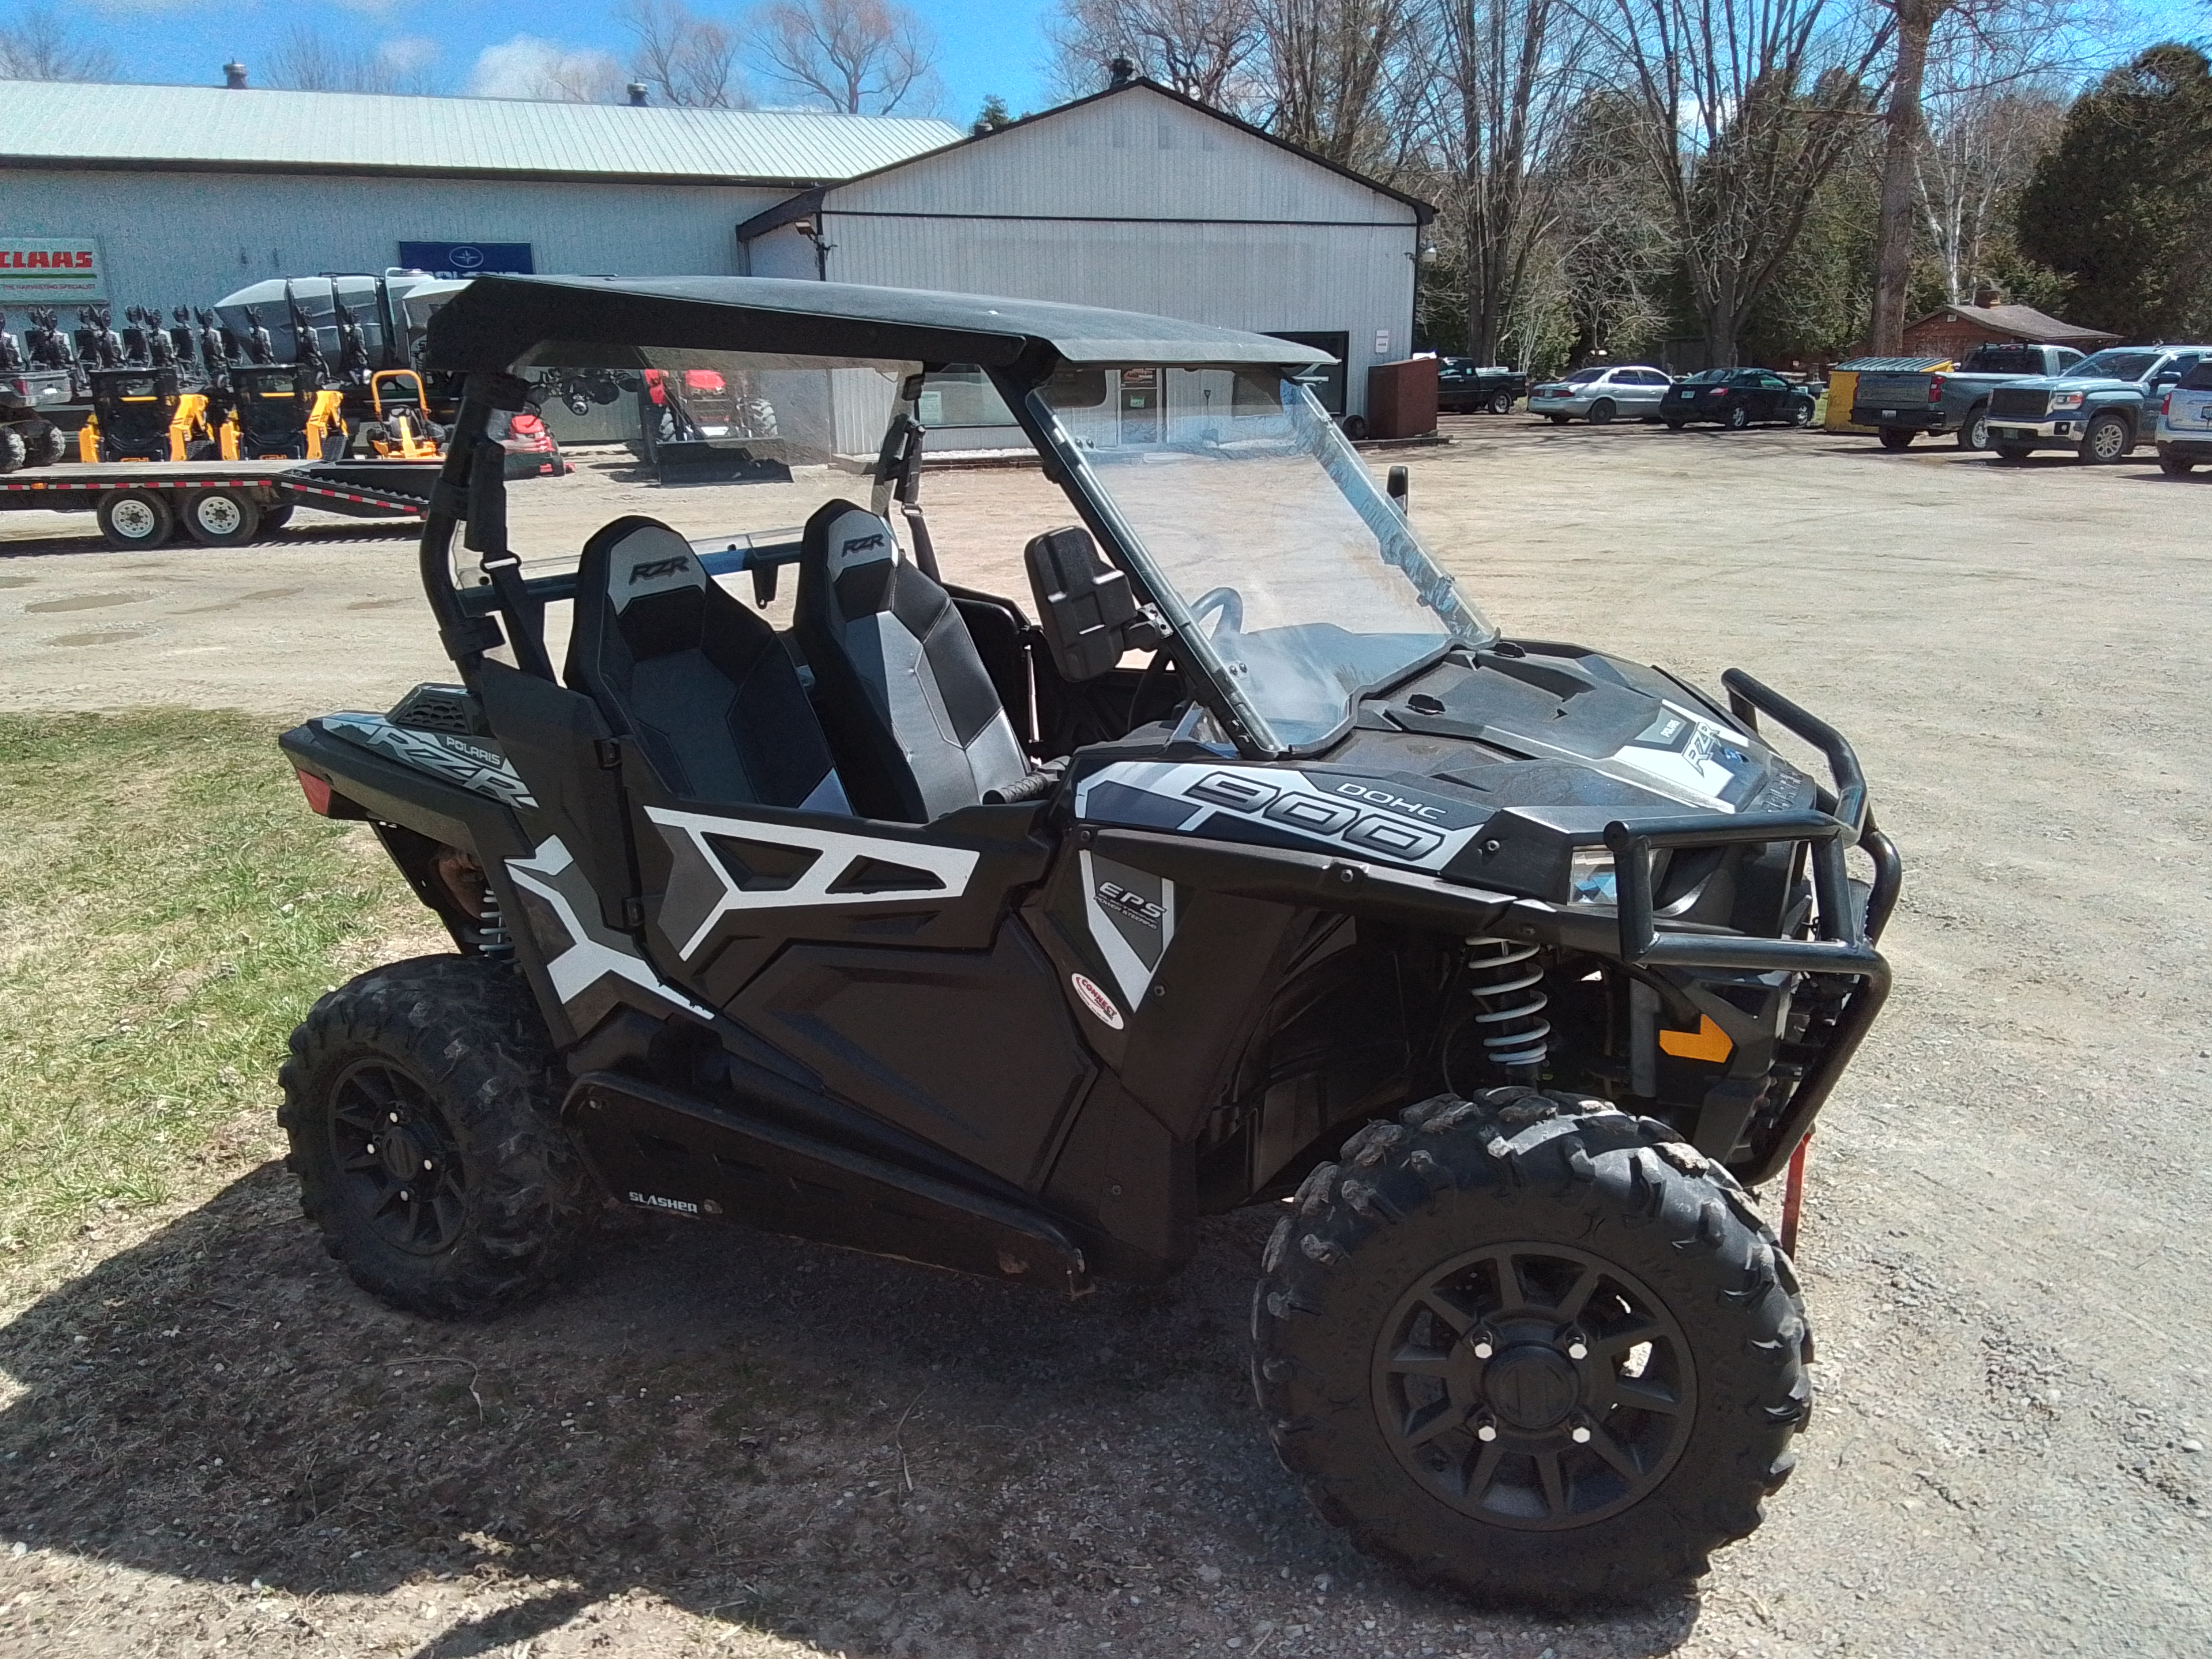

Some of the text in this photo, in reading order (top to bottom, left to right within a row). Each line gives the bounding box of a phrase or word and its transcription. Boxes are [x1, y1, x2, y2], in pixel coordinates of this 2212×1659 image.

[0, 251, 93, 268] CLAAS
[842, 533, 886, 558] RZR
[628, 555, 690, 586] RZR
[366, 726, 531, 809] RZR
[446, 735, 501, 766] POLARIS
[1681, 721, 1721, 779] RZR
[1181, 771, 1447, 862] 900
[1335, 782, 1448, 821] DOHC
[1099, 881, 1167, 918] EPS
[1082, 979, 1118, 1017] CONNECT
[628, 1191, 698, 1214] SLASHER
